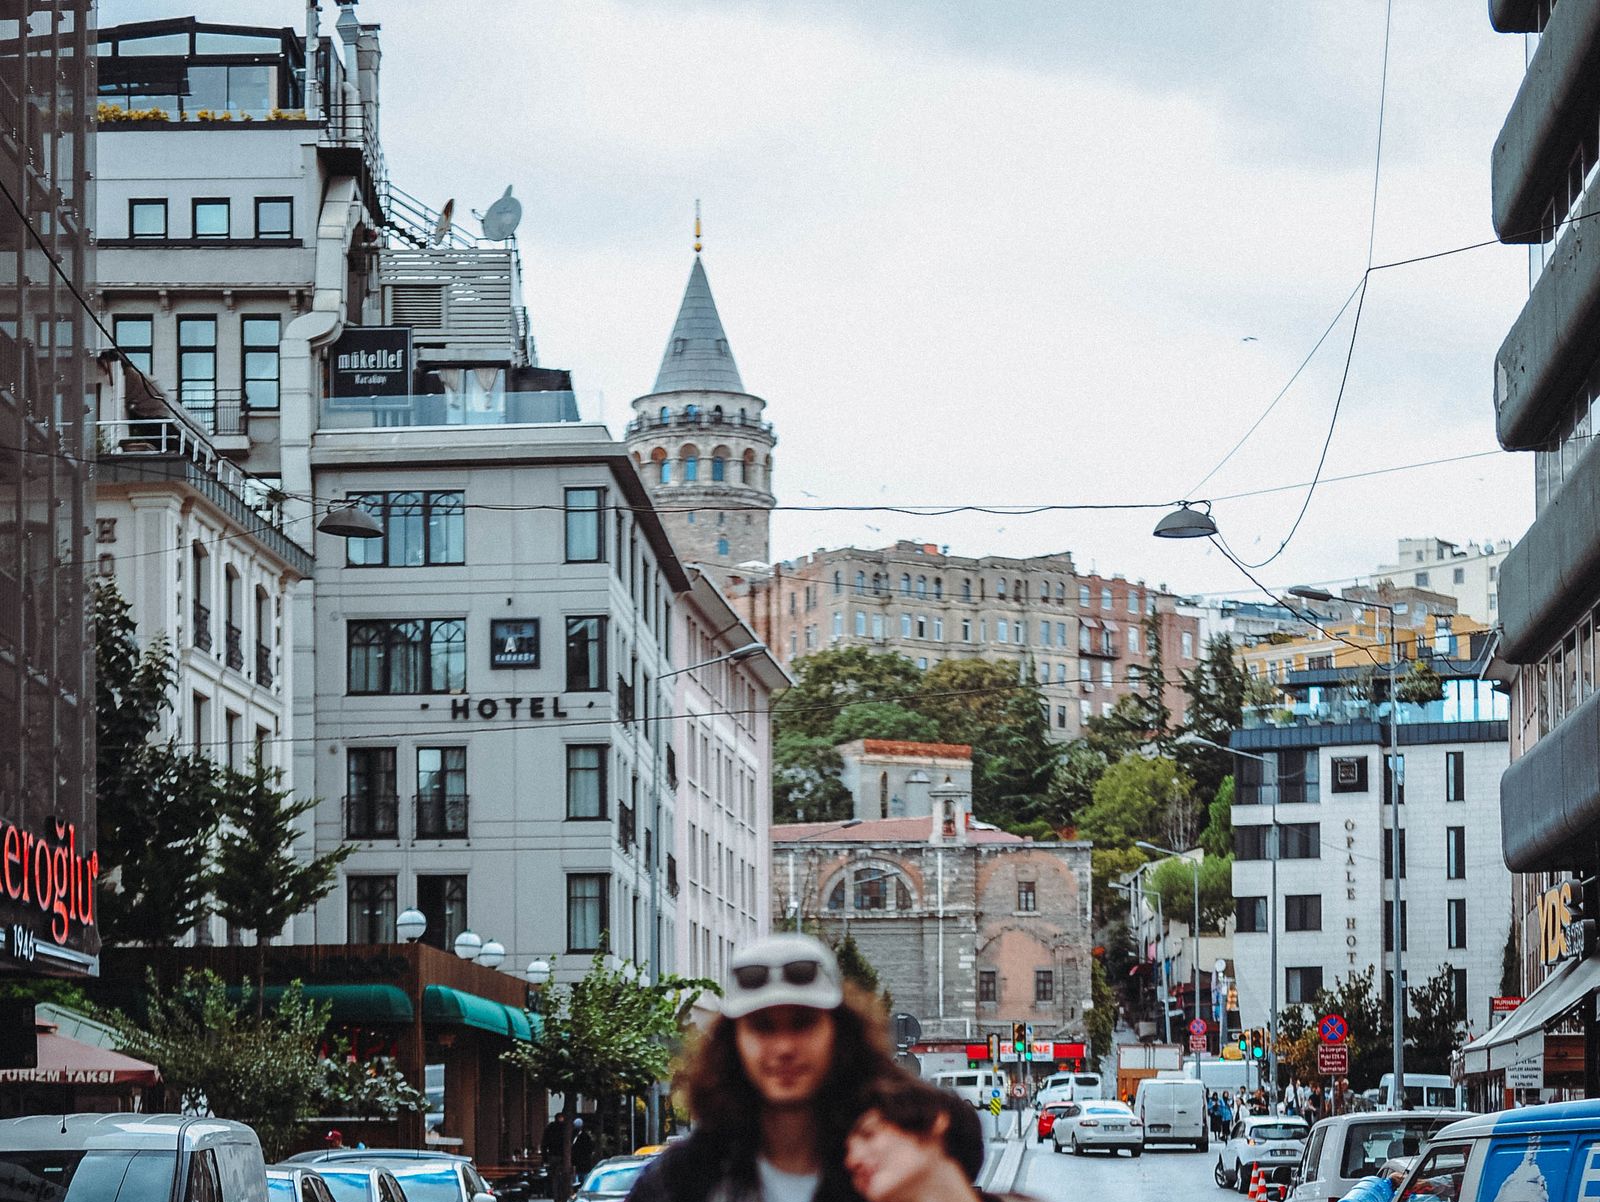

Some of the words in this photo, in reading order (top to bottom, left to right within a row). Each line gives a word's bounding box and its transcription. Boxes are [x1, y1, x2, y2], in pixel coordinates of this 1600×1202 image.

[338, 349, 404, 369] mükellef
[451, 696, 568, 720] HOTEL
[1344, 818, 1356, 901] OPALE
[0, 818, 94, 945] eroğlu
[1536, 882, 1572, 966] YDS
[13, 923, 35, 962] 1946
[1001, 1044, 1050, 1055] ECNE
[0, 1068, 60, 1083] TURİZM
[66, 1069, 115, 1084] TAKSİ
